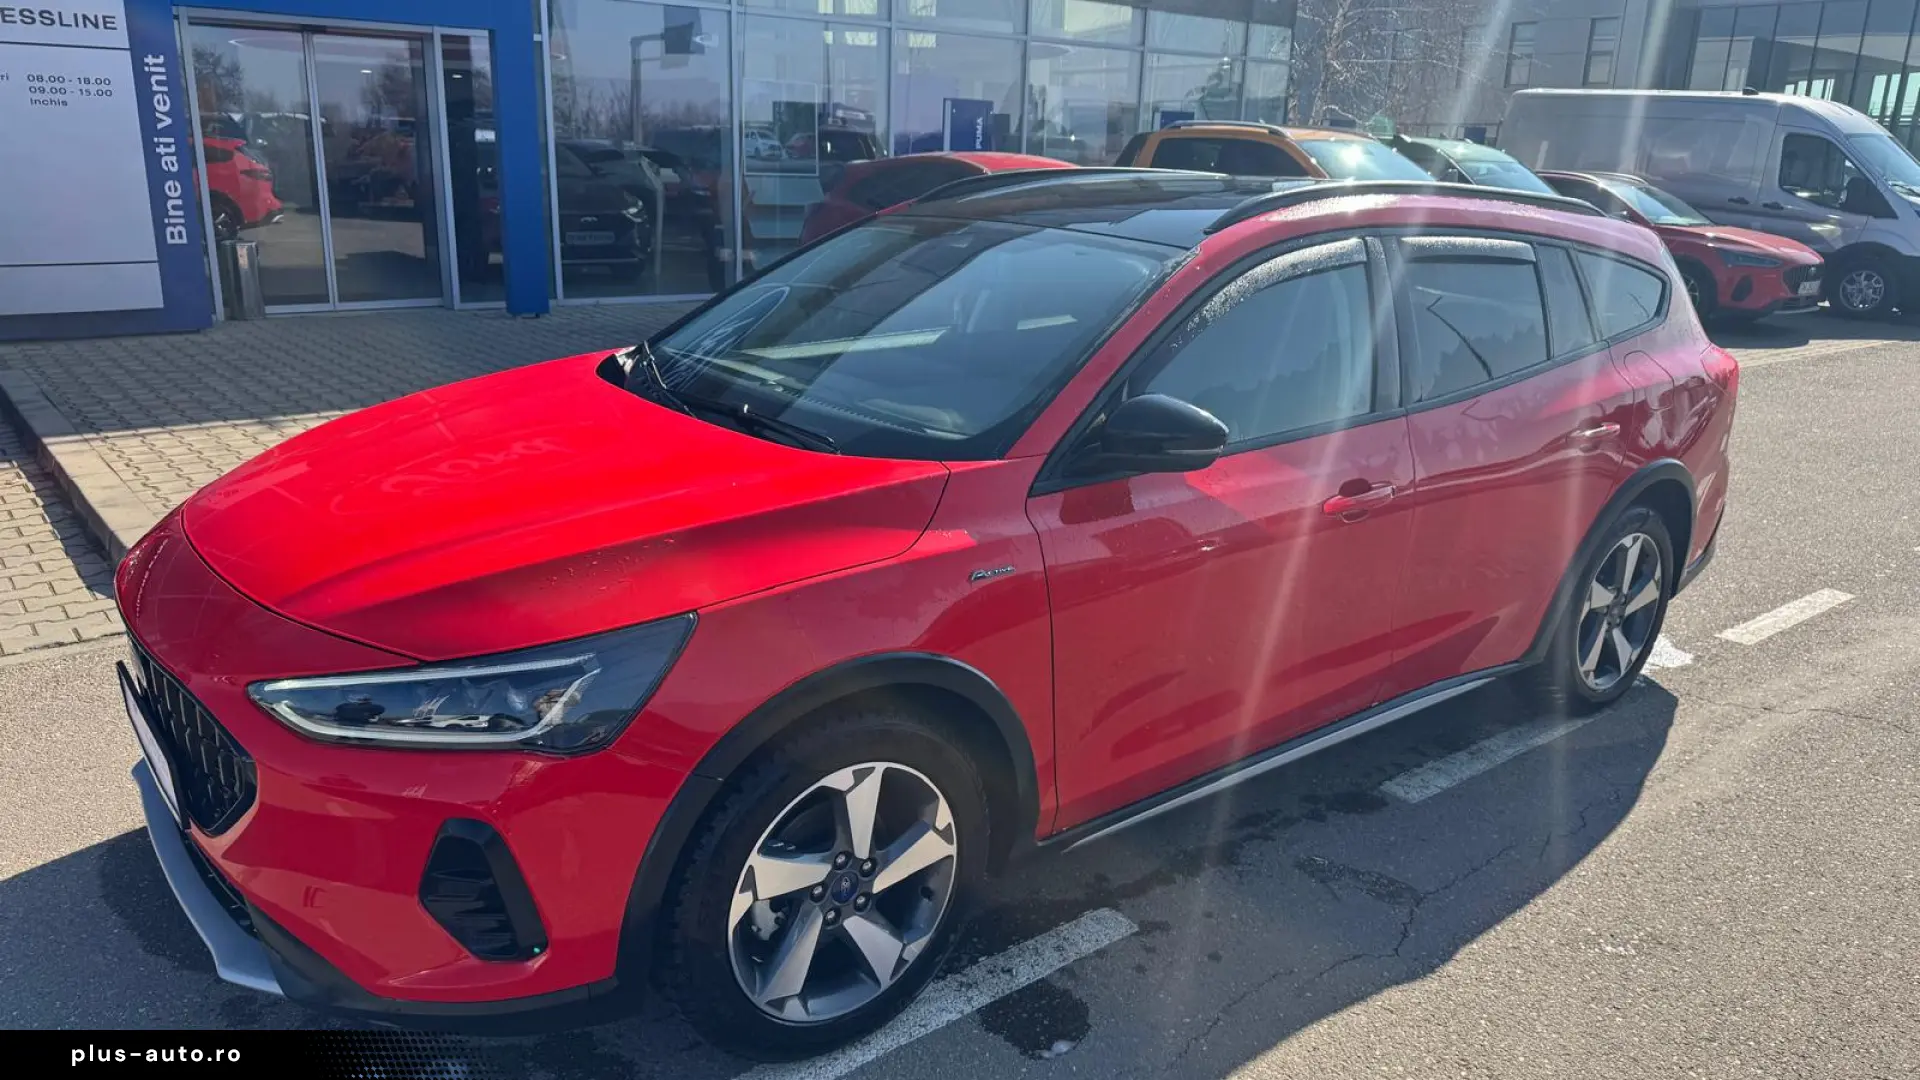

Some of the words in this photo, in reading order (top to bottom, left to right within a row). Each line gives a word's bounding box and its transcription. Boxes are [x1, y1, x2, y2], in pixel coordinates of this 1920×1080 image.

[0, 7, 117, 30] ESSLINE
[27, 74, 65, 84] 08.00
[77, 77, 111, 86] 18.00
[28, 86, 67, 95] 09.00
[79, 88, 112, 97] 15.00
[143, 54, 172, 129] venit
[153, 137, 179, 172] ati
[164, 179, 187, 245] Bine
